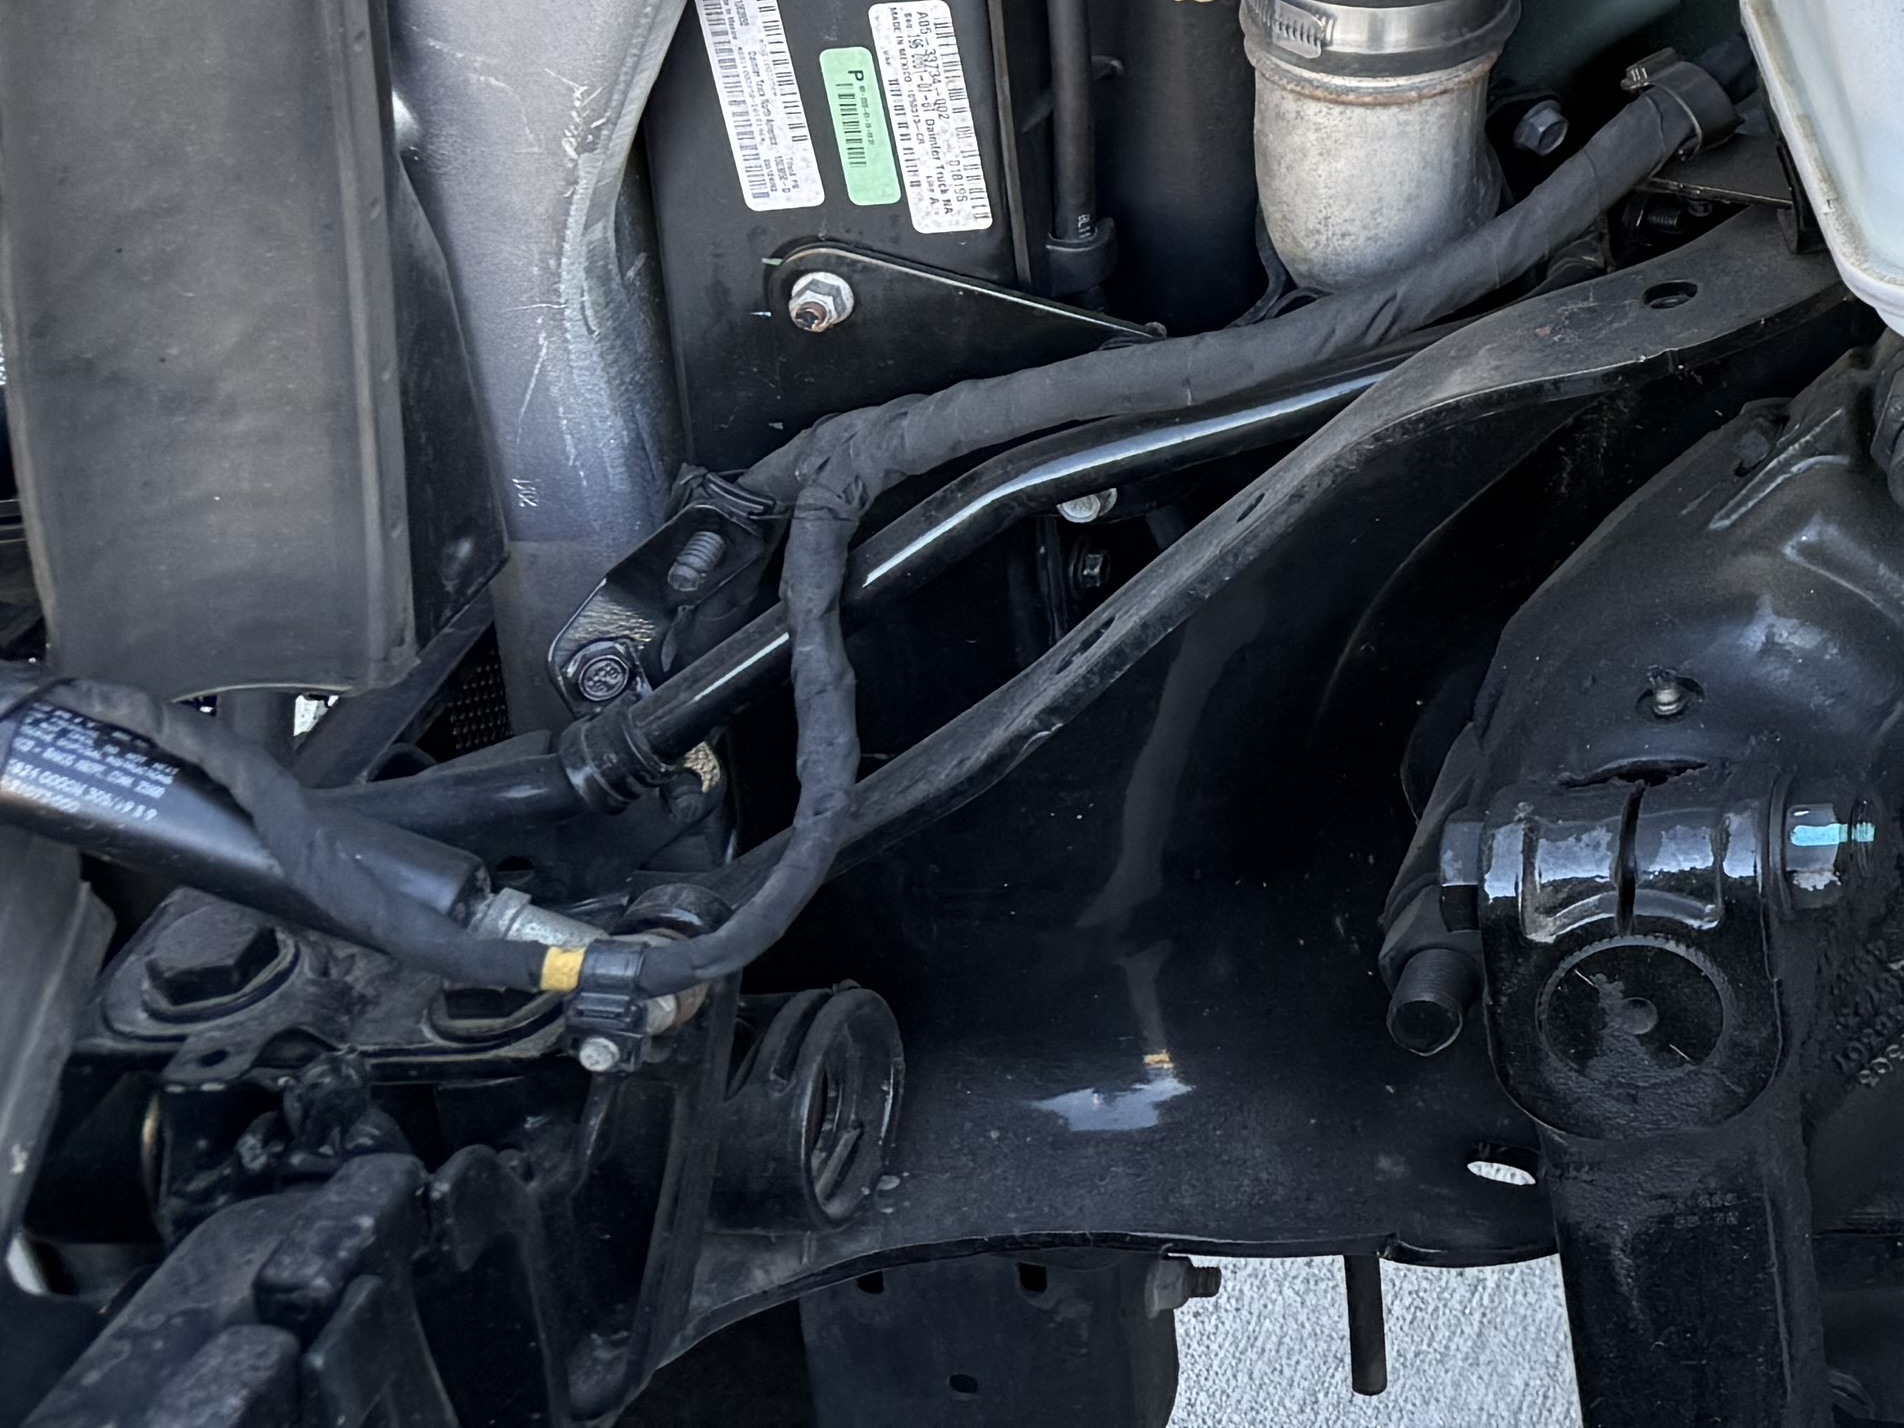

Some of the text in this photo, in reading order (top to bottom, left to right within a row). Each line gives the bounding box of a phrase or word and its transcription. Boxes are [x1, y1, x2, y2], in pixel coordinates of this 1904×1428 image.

[847, 69, 865, 82] P
[889, 6, 902, 32] MADE
[898, 46, 912, 83] MEXICO
[924, 119, 941, 164] Daimler
[935, 164, 950, 196] Truck
